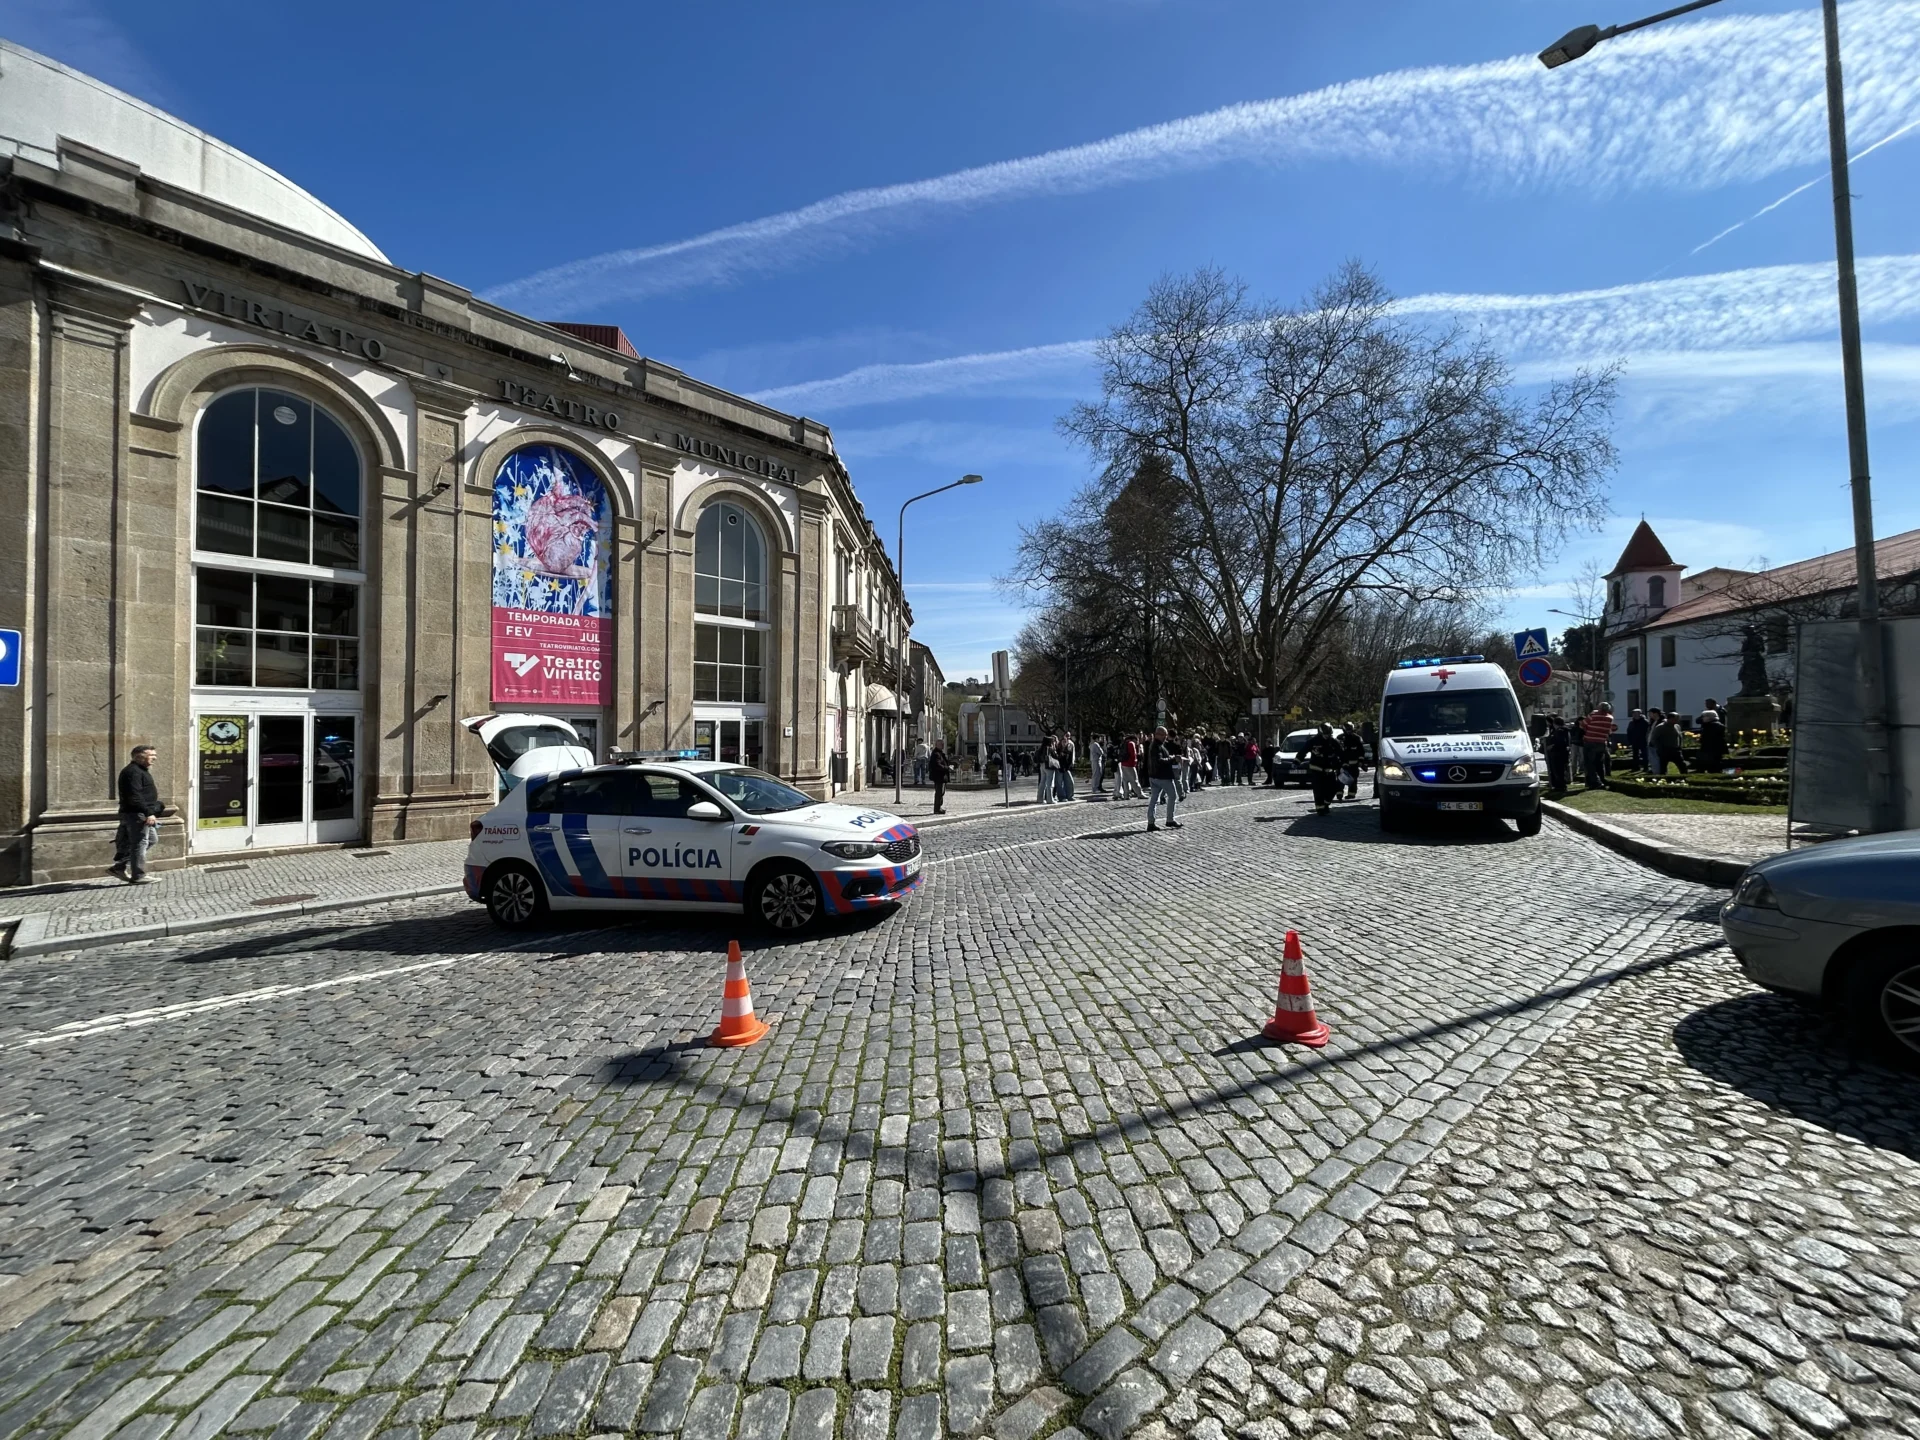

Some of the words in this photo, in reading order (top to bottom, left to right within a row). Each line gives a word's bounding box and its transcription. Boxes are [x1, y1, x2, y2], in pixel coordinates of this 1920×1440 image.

[180, 279, 388, 362] VIRIATO
[498, 379, 621, 431] TEATRO
[677, 433, 800, 484] MUNICIPAL
[507, 611, 580, 627] TEMPORADA
[506, 625, 533, 637] FEV
[580, 632, 601, 643] JUL
[540, 642, 601, 652] TEATROVIRIATO.COM
[543, 655, 602, 670] Teatro
[543, 667, 602, 682] Viriato
[628, 842, 722, 869] POLÍCIA
